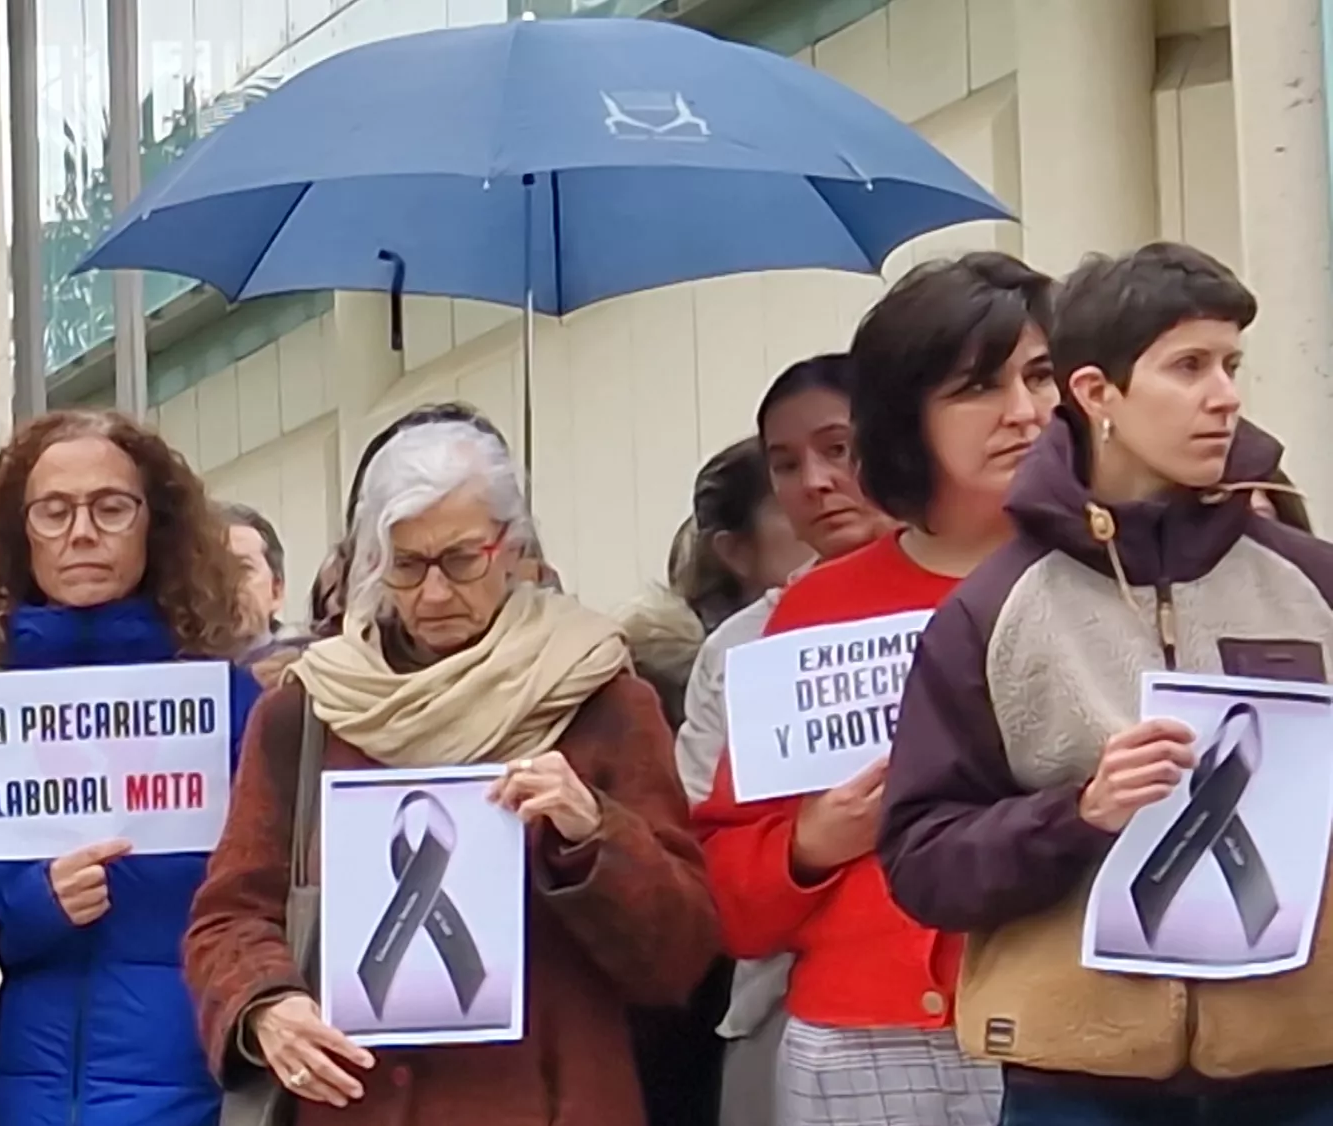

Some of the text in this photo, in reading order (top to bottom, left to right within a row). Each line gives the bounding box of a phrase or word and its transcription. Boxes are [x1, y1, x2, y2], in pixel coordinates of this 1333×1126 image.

[796, 662, 909, 712] DERECH
[20, 697, 215, 742] PRECARIEDAD
[775, 724, 790, 759] Y
[126, 772, 203, 812] MATA
